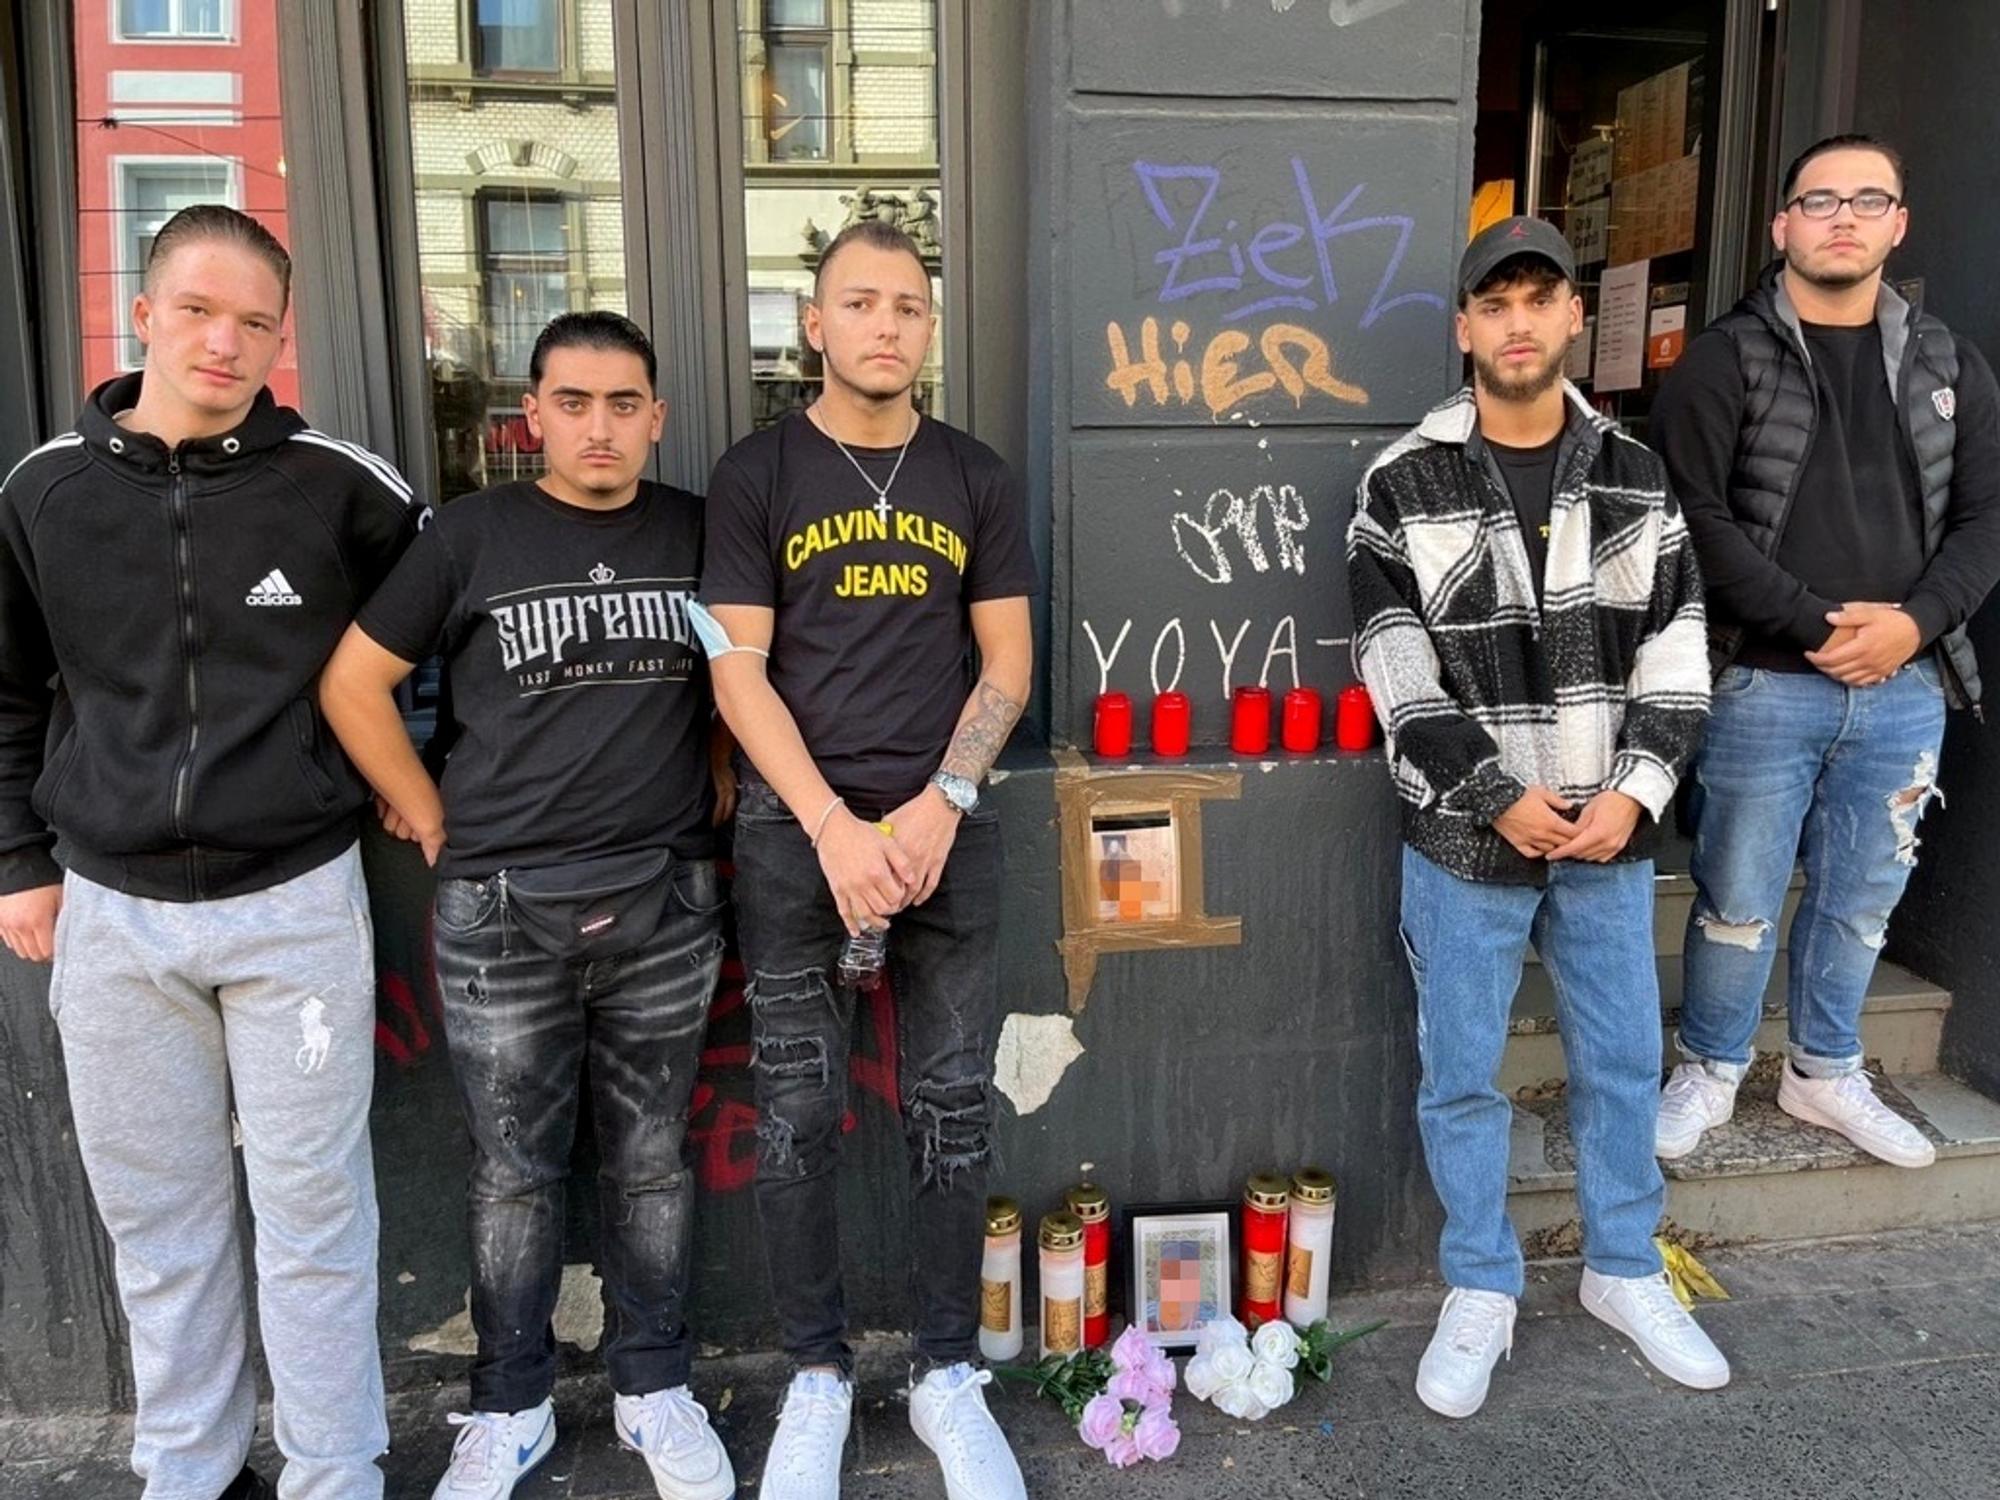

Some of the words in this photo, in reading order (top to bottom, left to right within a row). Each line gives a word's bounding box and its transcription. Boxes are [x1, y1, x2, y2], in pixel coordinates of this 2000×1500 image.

[786, 509, 888, 570] CALVIN
[896, 511, 967, 576] KLEIN
[835, 564, 928, 597] JEANS
[245, 592, 302, 607] adidas
[564, 661, 614, 678] MONEY
[628, 658, 665, 673] FAST
